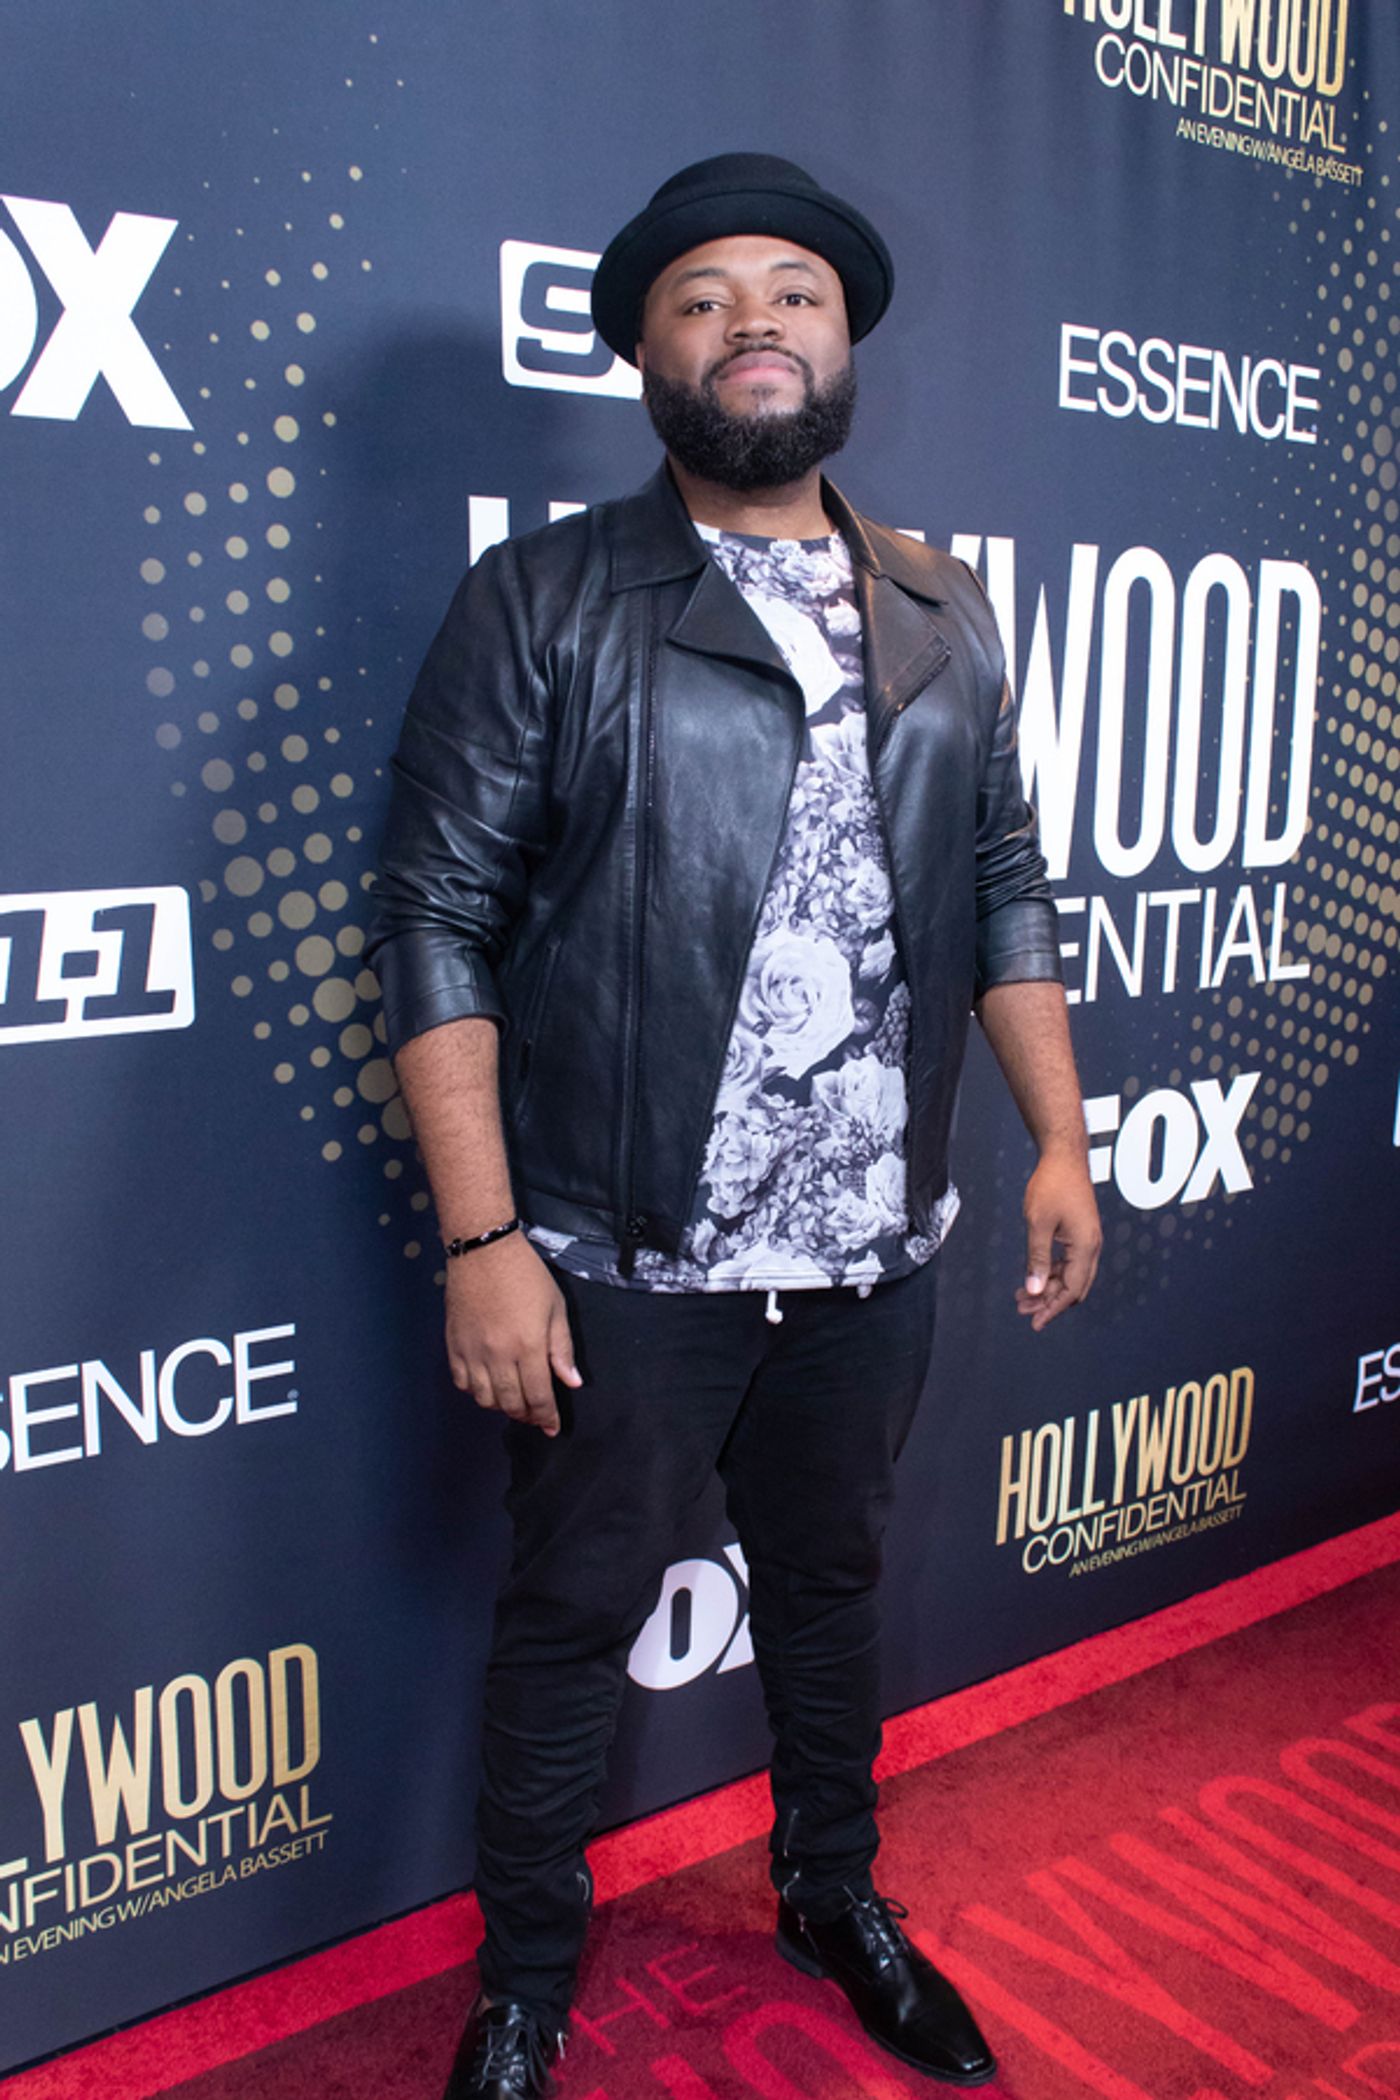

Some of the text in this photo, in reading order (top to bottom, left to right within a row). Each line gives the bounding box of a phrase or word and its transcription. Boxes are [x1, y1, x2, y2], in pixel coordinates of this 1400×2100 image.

[1095, 32, 1346, 153] CONFIDENTIAL
[1316, 155, 1364, 187] BASSETT
[1059, 322, 1321, 445] ESSENCE
[1053, 882, 1311, 1005] NTIAL
[0, 1323, 297, 1473] ENCE
[995, 1366, 1255, 1547] HOLLYWOOD
[1021, 1469, 1247, 1574] CONFIDENTIAL
[0, 1643, 321, 1880] YWOOD
[13, 1906, 116, 1962] EVENING
[239, 1829, 329, 1880] BASSETT
